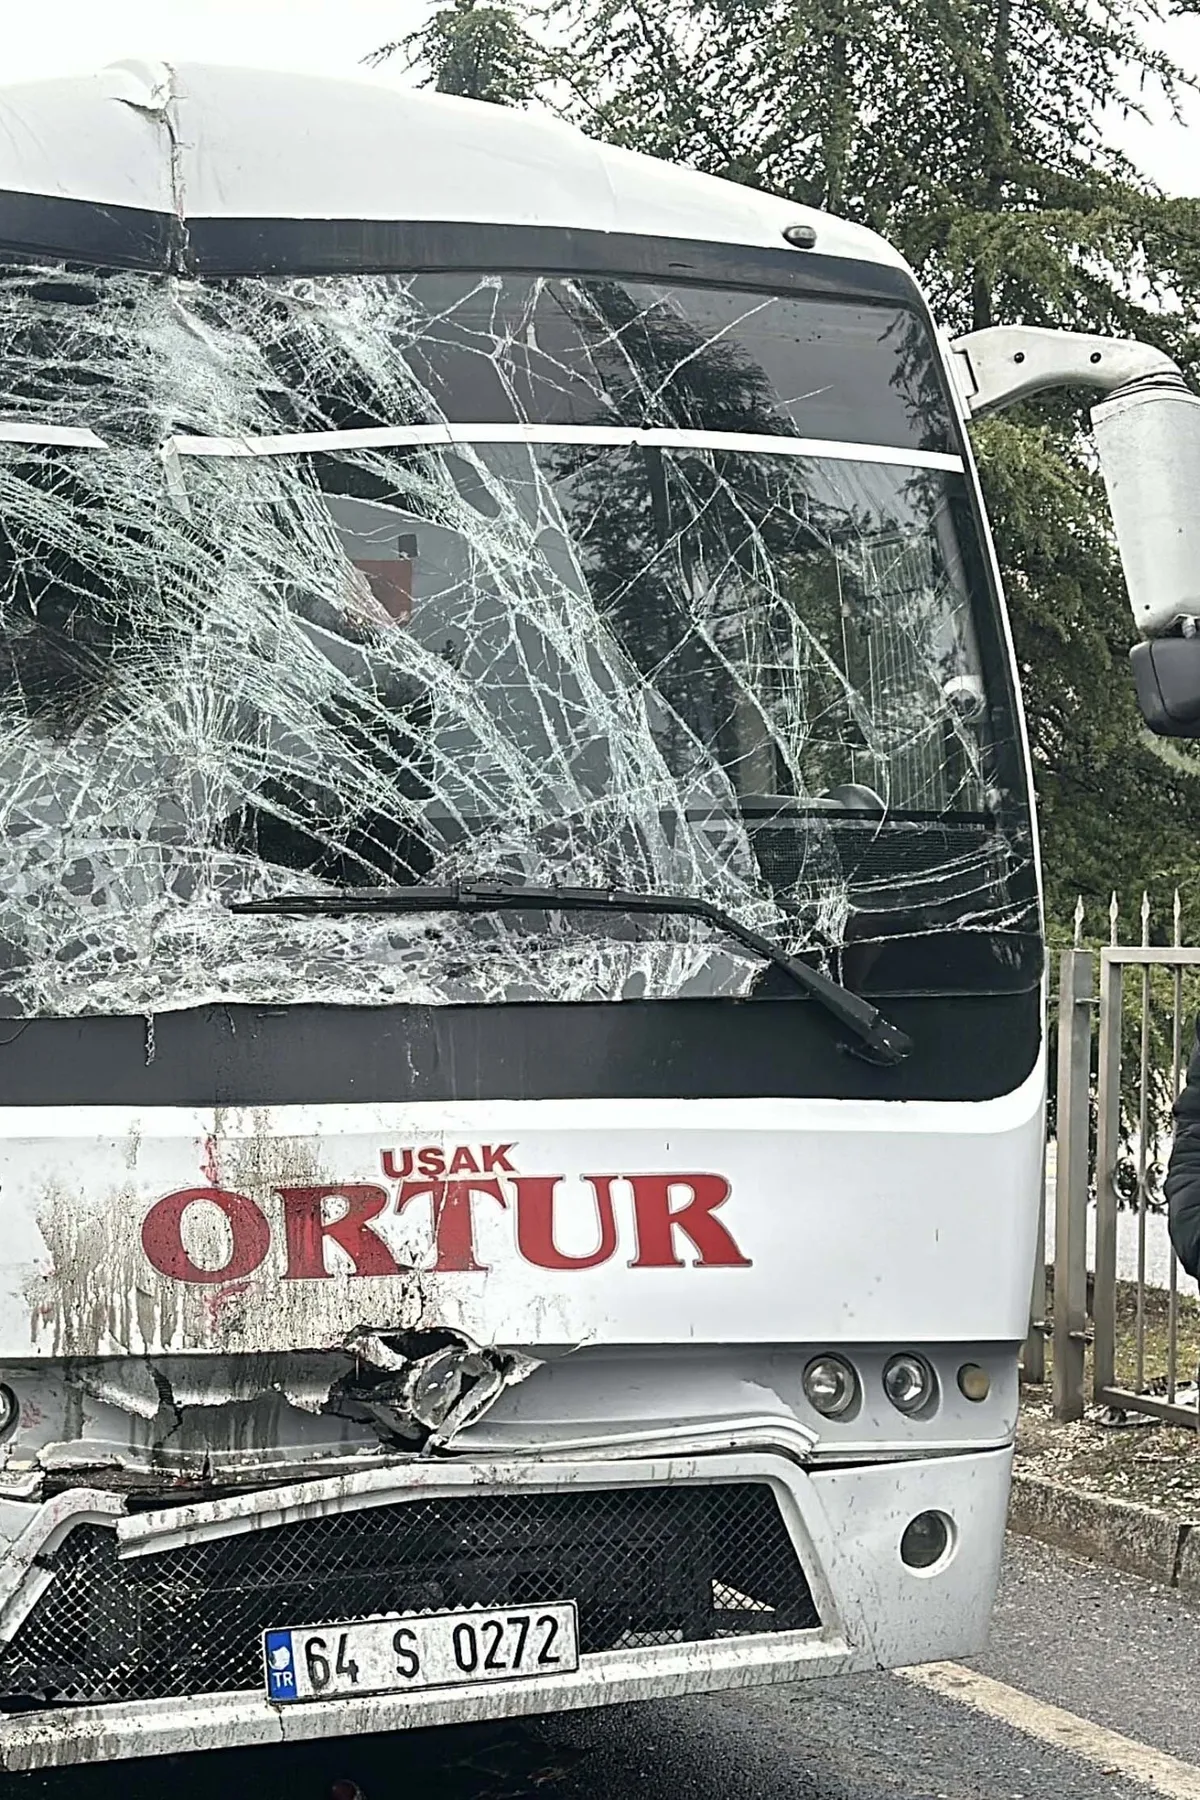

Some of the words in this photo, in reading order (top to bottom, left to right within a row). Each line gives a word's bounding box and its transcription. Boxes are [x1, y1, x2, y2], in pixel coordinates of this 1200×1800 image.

[380, 1143, 518, 1180] UŞAK
[141, 1172, 753, 1283] ORTUR
[272, 1671, 294, 1688] TR
[304, 1632, 360, 1691] 64
[392, 1627, 420, 1679] S
[452, 1614, 561, 1673] 0272
